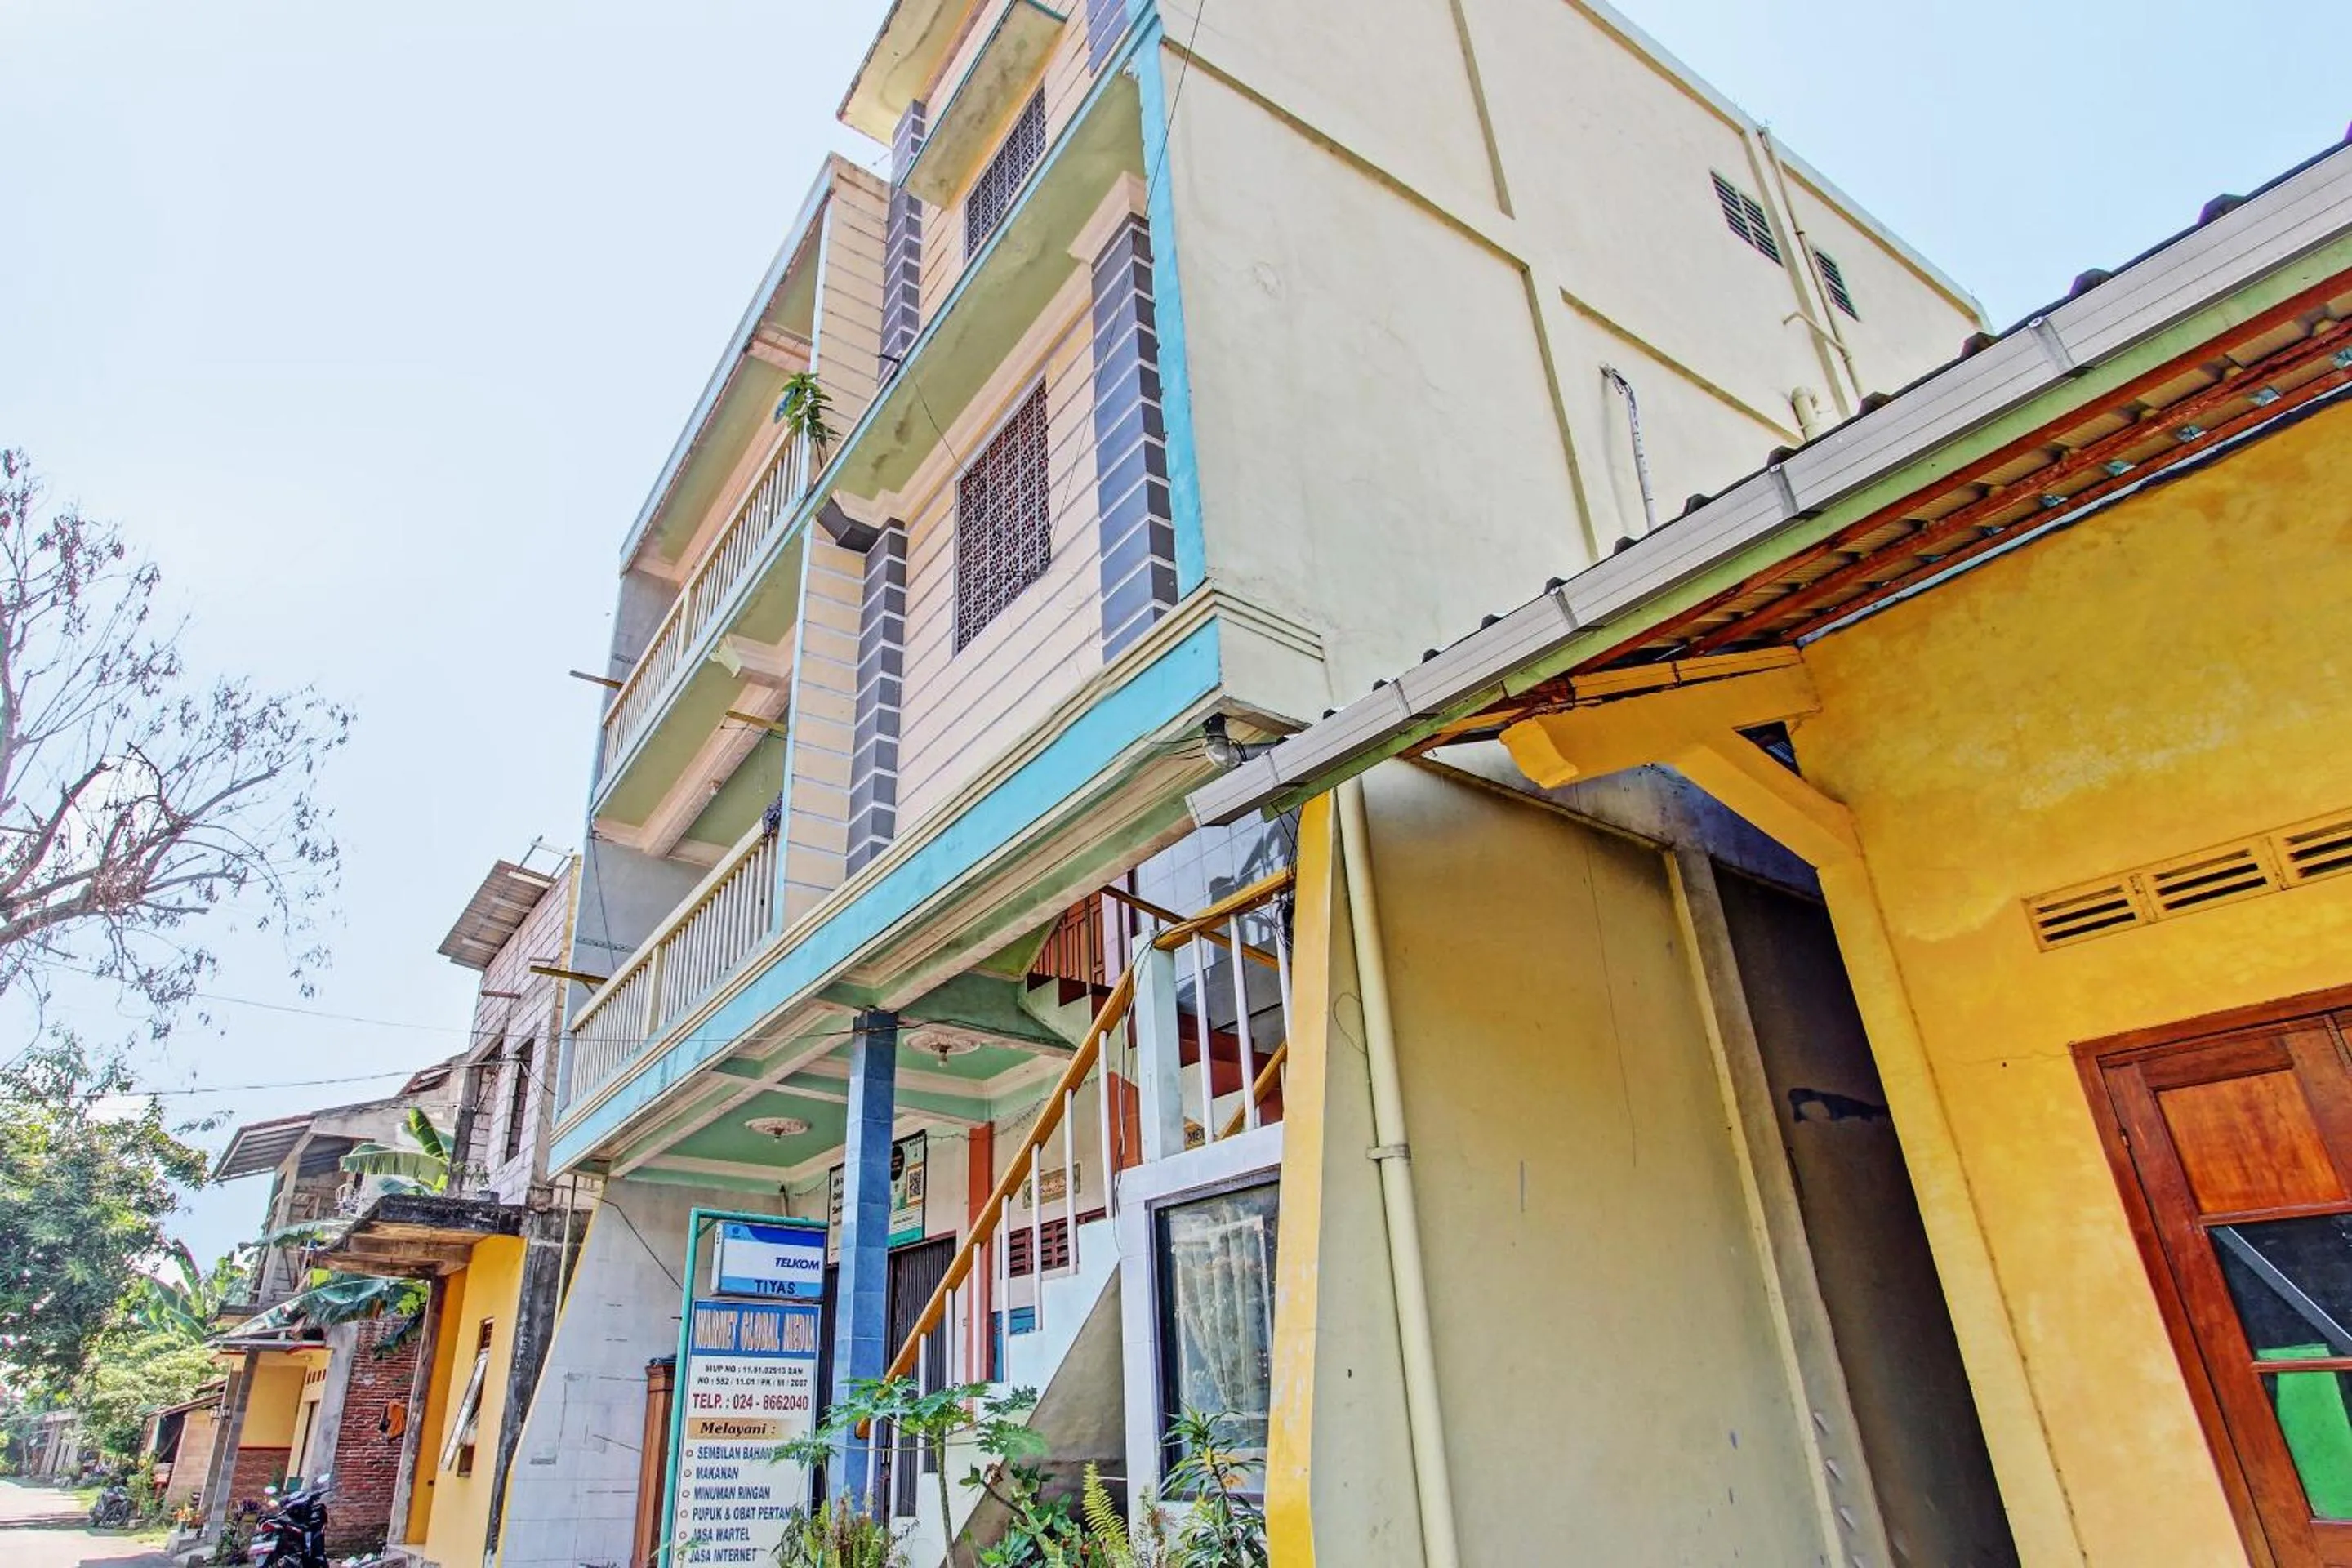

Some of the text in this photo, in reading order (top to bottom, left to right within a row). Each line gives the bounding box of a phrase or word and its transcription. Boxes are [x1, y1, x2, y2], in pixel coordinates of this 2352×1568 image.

[775, 1257, 820, 1270] TELKOM
[755, 1280, 795, 1294] TIYAS
[741, 1312, 780, 1352] GLOBAL
[782, 1313, 815, 1352] MEDIA
[733, 1394, 753, 1410] 024
[763, 1395, 809, 1410] 8662040
[700, 1422, 767, 1437] Melayani
[697, 1446, 741, 1460] SEMBILAN
[696, 1467, 739, 1480] MAKANAN
[694, 1486, 770, 1500] MINUMAN RINGAN
[693, 1508, 722, 1521] PUPUK
[724, 1508, 731, 1520] &
[733, 1507, 756, 1520] OBAT
[692, 1527, 751, 1542] JASA WARTEL
[688, 1548, 757, 1563] JASA INTERNET
